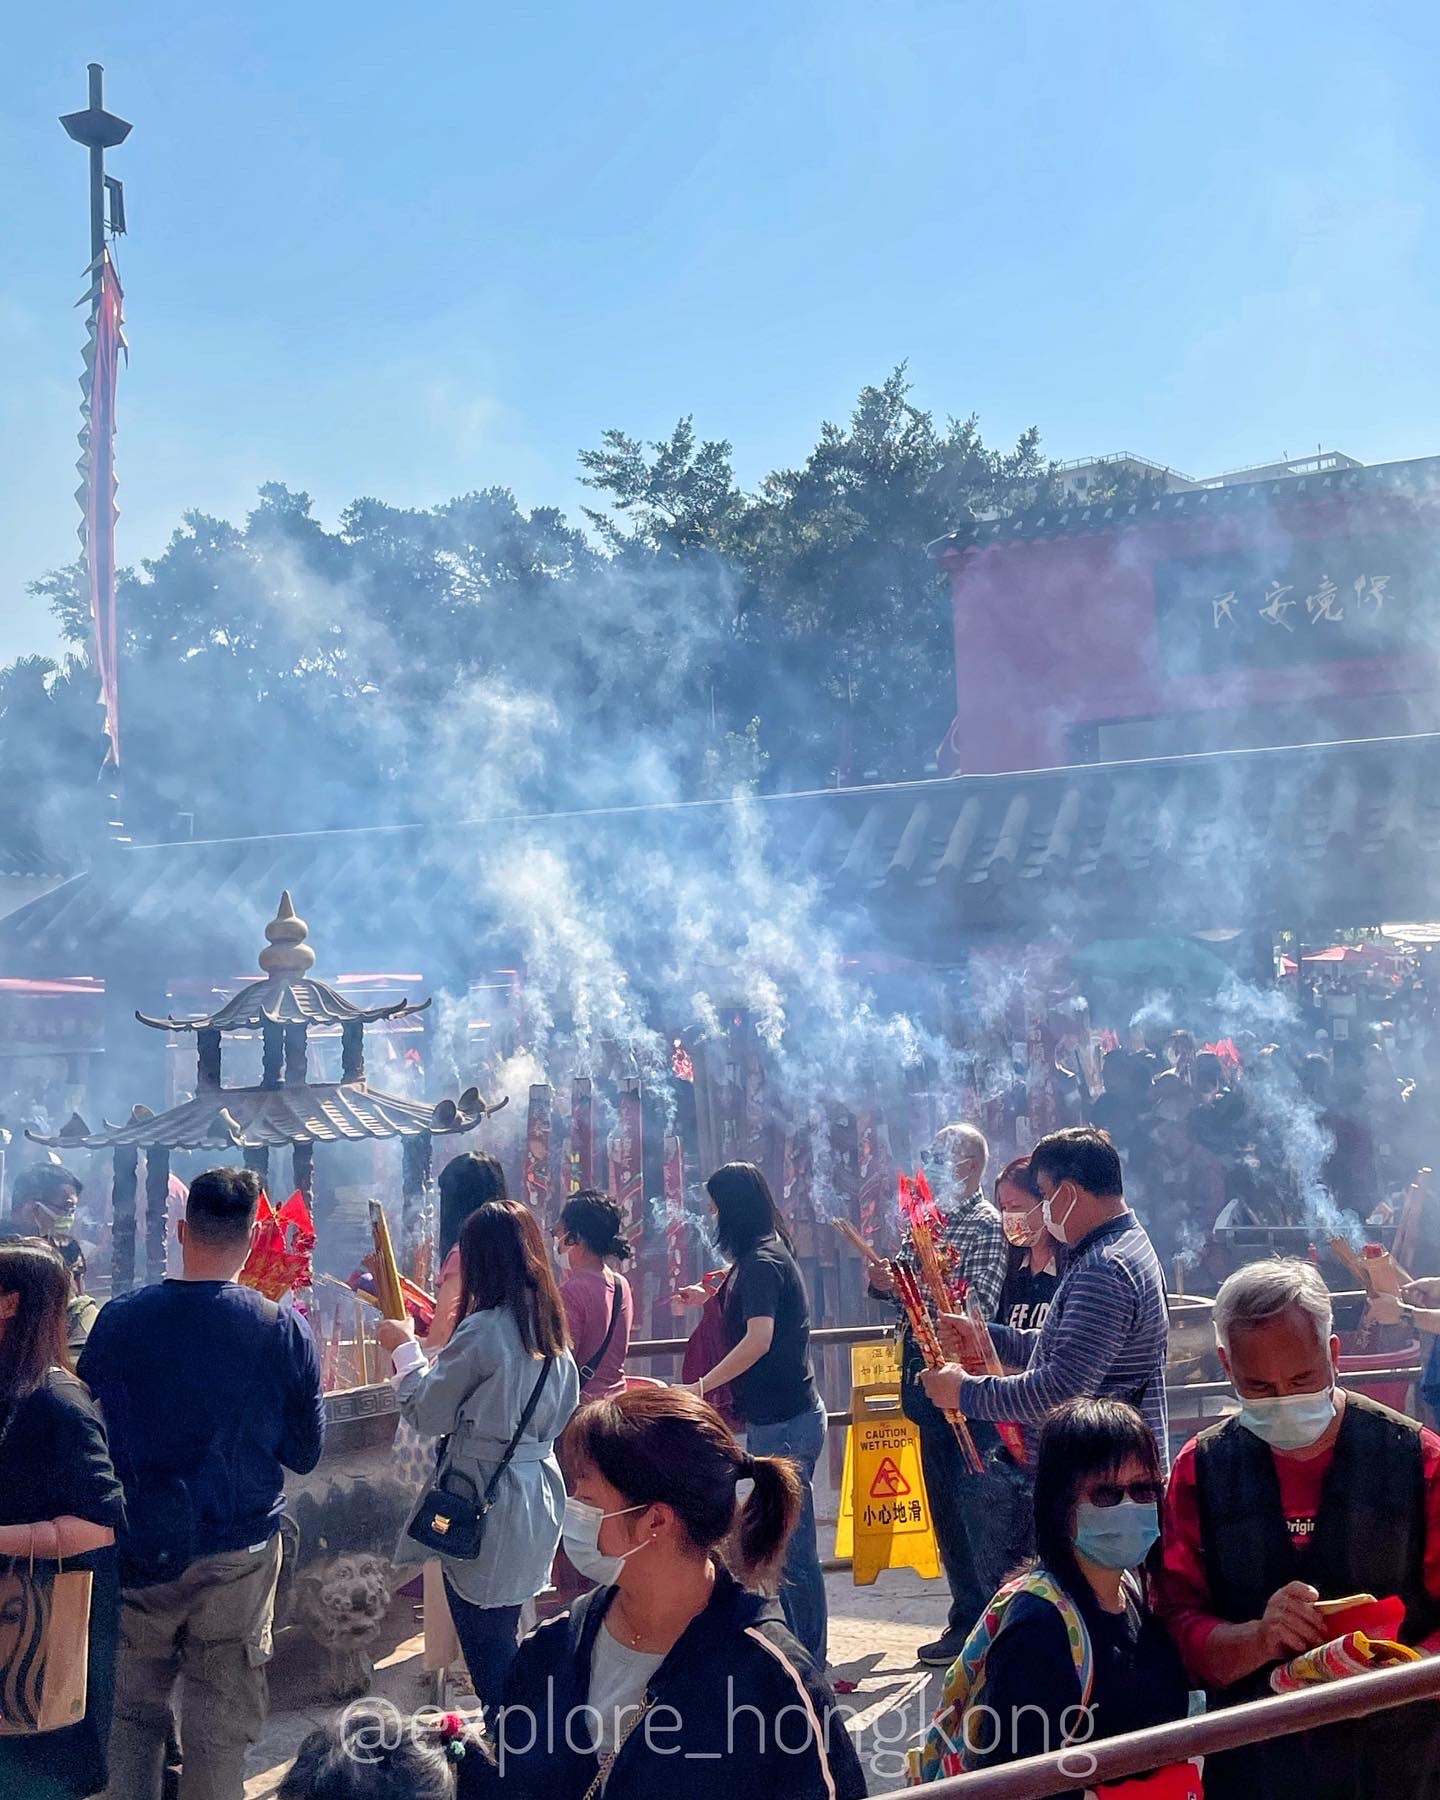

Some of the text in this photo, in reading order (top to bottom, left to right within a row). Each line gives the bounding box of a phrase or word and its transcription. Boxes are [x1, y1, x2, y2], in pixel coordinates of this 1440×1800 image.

[860, 1364, 901, 1376] 如非工
[865, 1427, 907, 1440] CAUTION
[860, 1437, 914, 1452] WET FLOOR
[863, 1500, 922, 1527] 小心地滑
